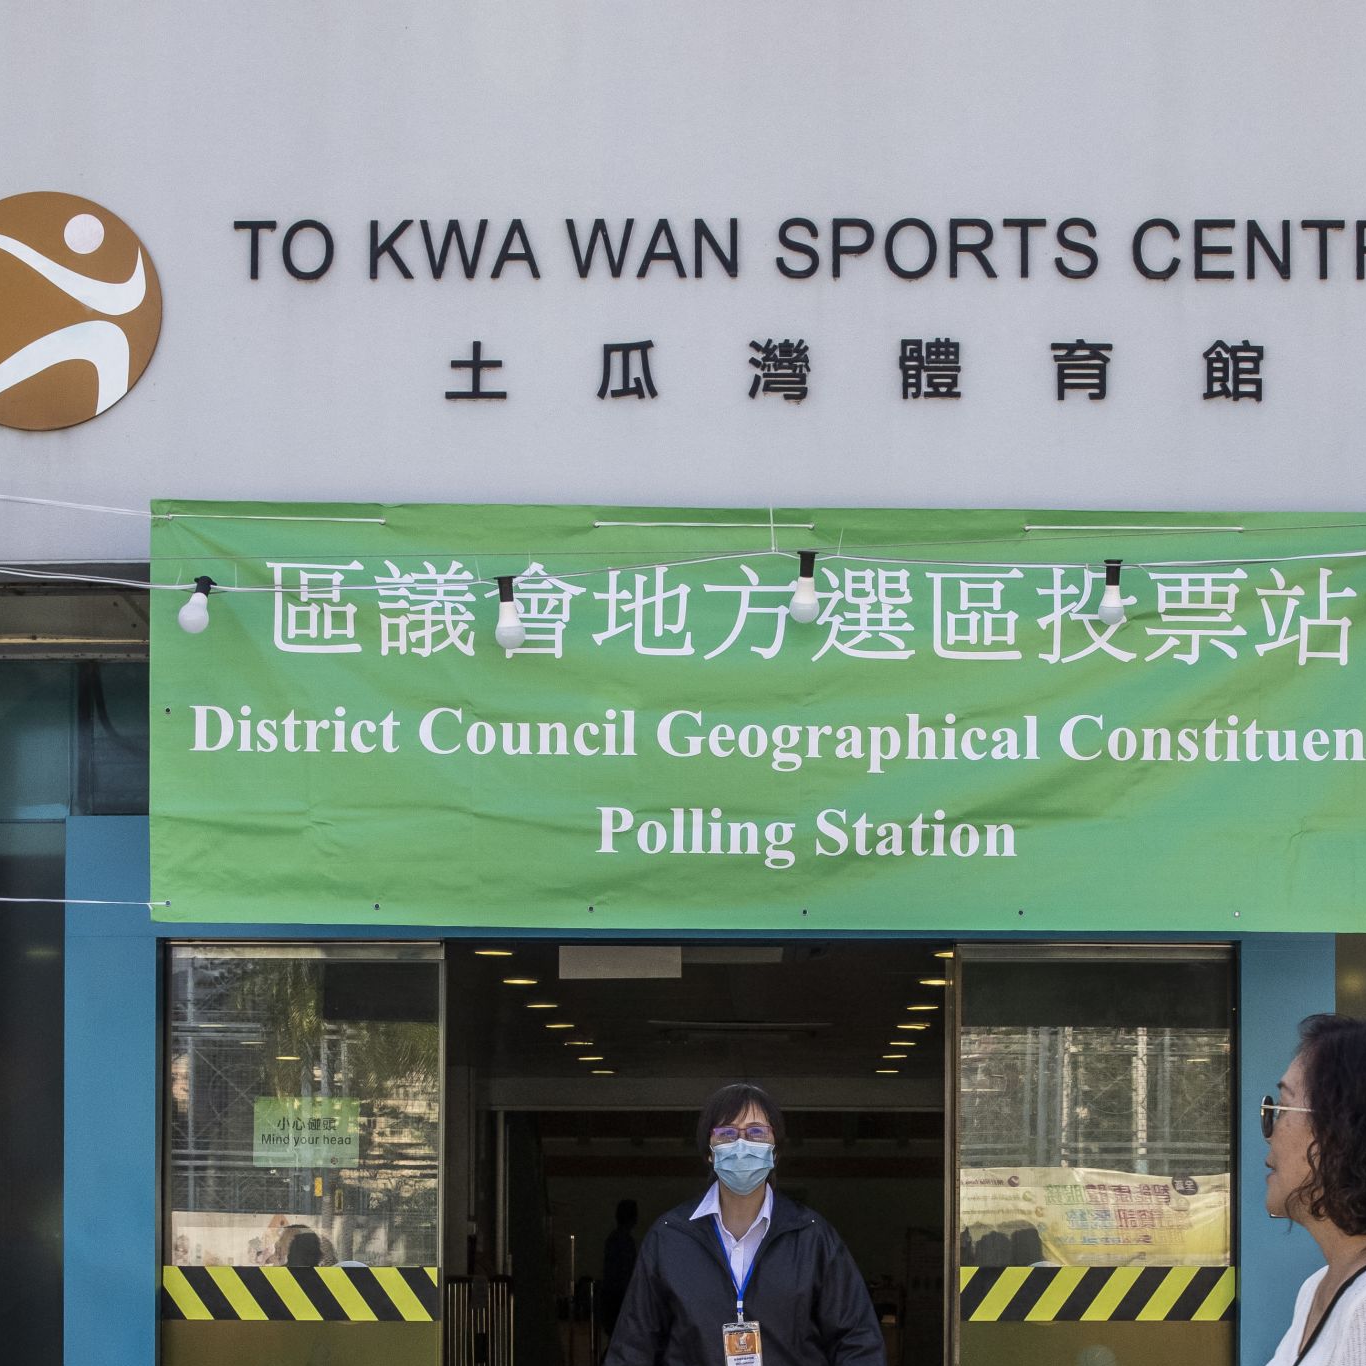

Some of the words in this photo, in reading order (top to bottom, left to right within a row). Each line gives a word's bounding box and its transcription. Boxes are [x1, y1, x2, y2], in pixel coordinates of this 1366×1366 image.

[234, 219, 335, 280] TO
[369, 219, 541, 280] KWA
[566, 218, 739, 279] WAN
[775, 218, 1099, 282] SPORTS
[445, 337, 1267, 404] 土瓜灣體育館
[266, 559, 1359, 666] 區議會地方選區投票站
[190, 705, 401, 754] District
[418, 707, 637, 756] Council
[656, 710, 1040, 774] Geographical
[596, 806, 796, 869] Polling
[815, 808, 1017, 857] Station
[261, 1134, 290, 1145] Mind
[294, 1136, 319, 1147] your
[323, 1134, 352, 1145] head
[277, 1116, 337, 1131] 小心碰頭
